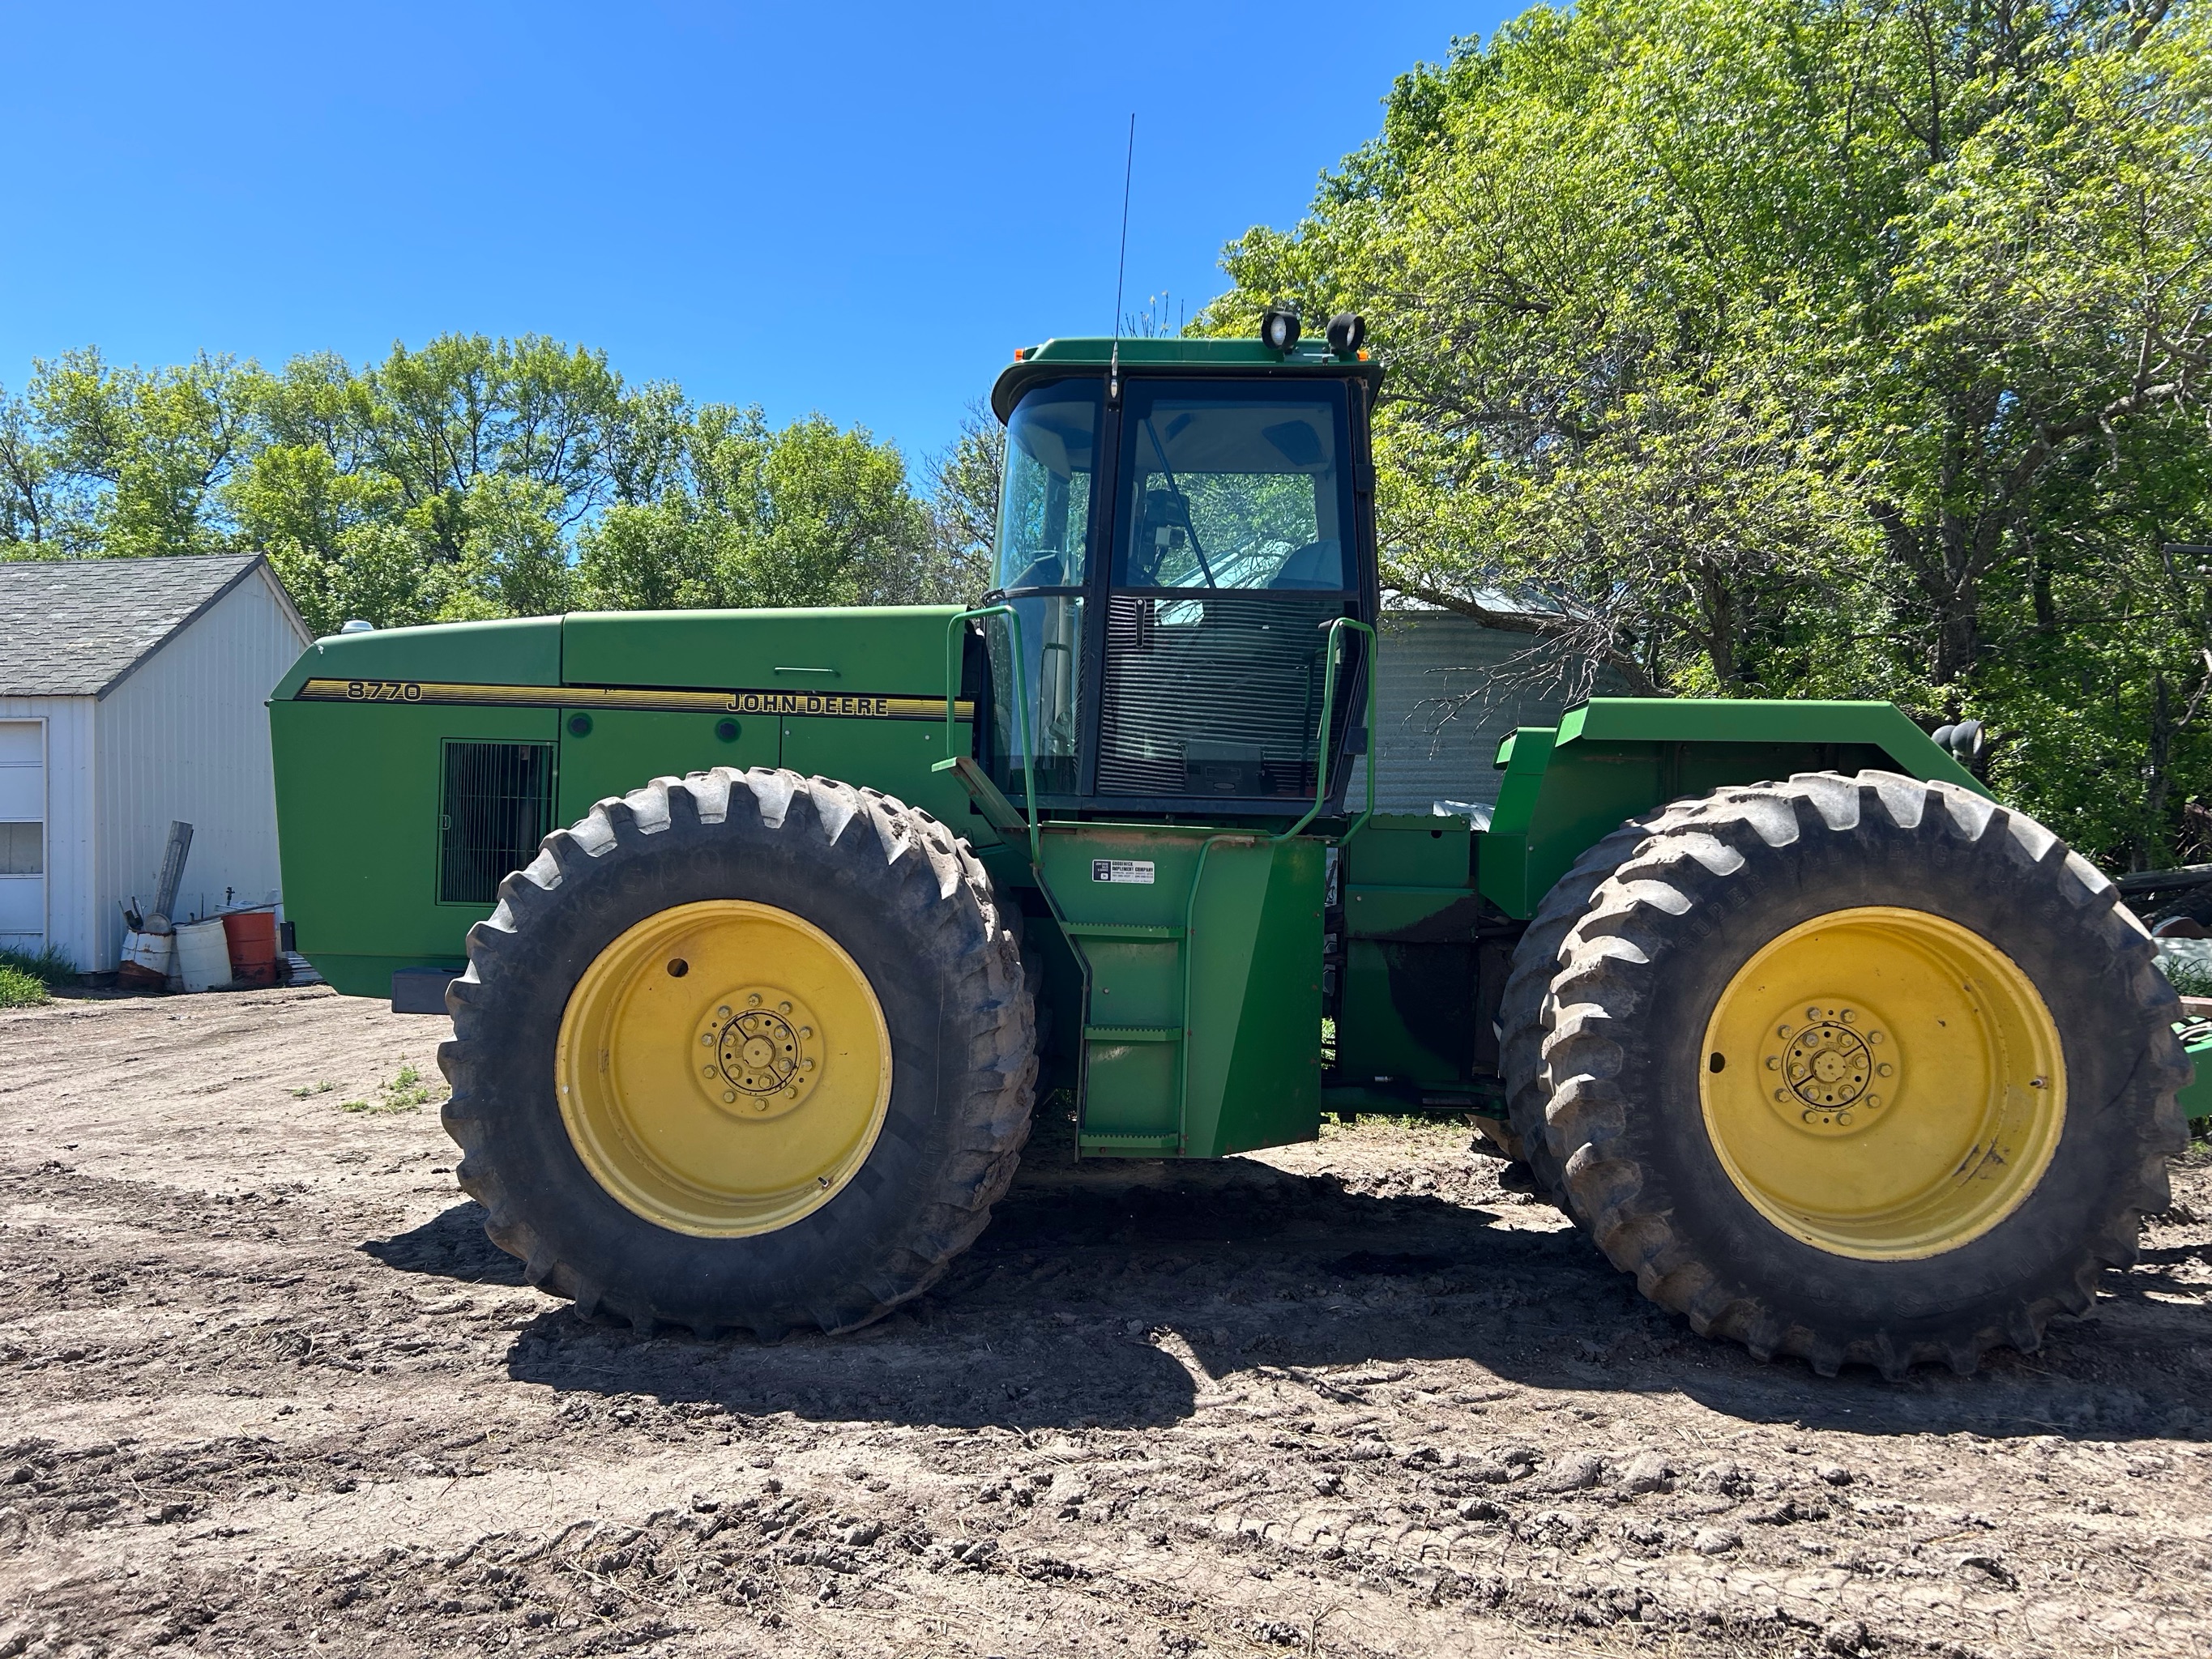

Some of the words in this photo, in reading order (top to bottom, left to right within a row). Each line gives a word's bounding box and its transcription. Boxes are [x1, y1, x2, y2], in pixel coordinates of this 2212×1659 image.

[347, 681, 422, 702] 8770
[727, 693, 797, 714] JOHN
[805, 696, 889, 716] DEERE
[1677, 871, 1770, 953] SUPER
[1784, 842, 1843, 877] ALL
